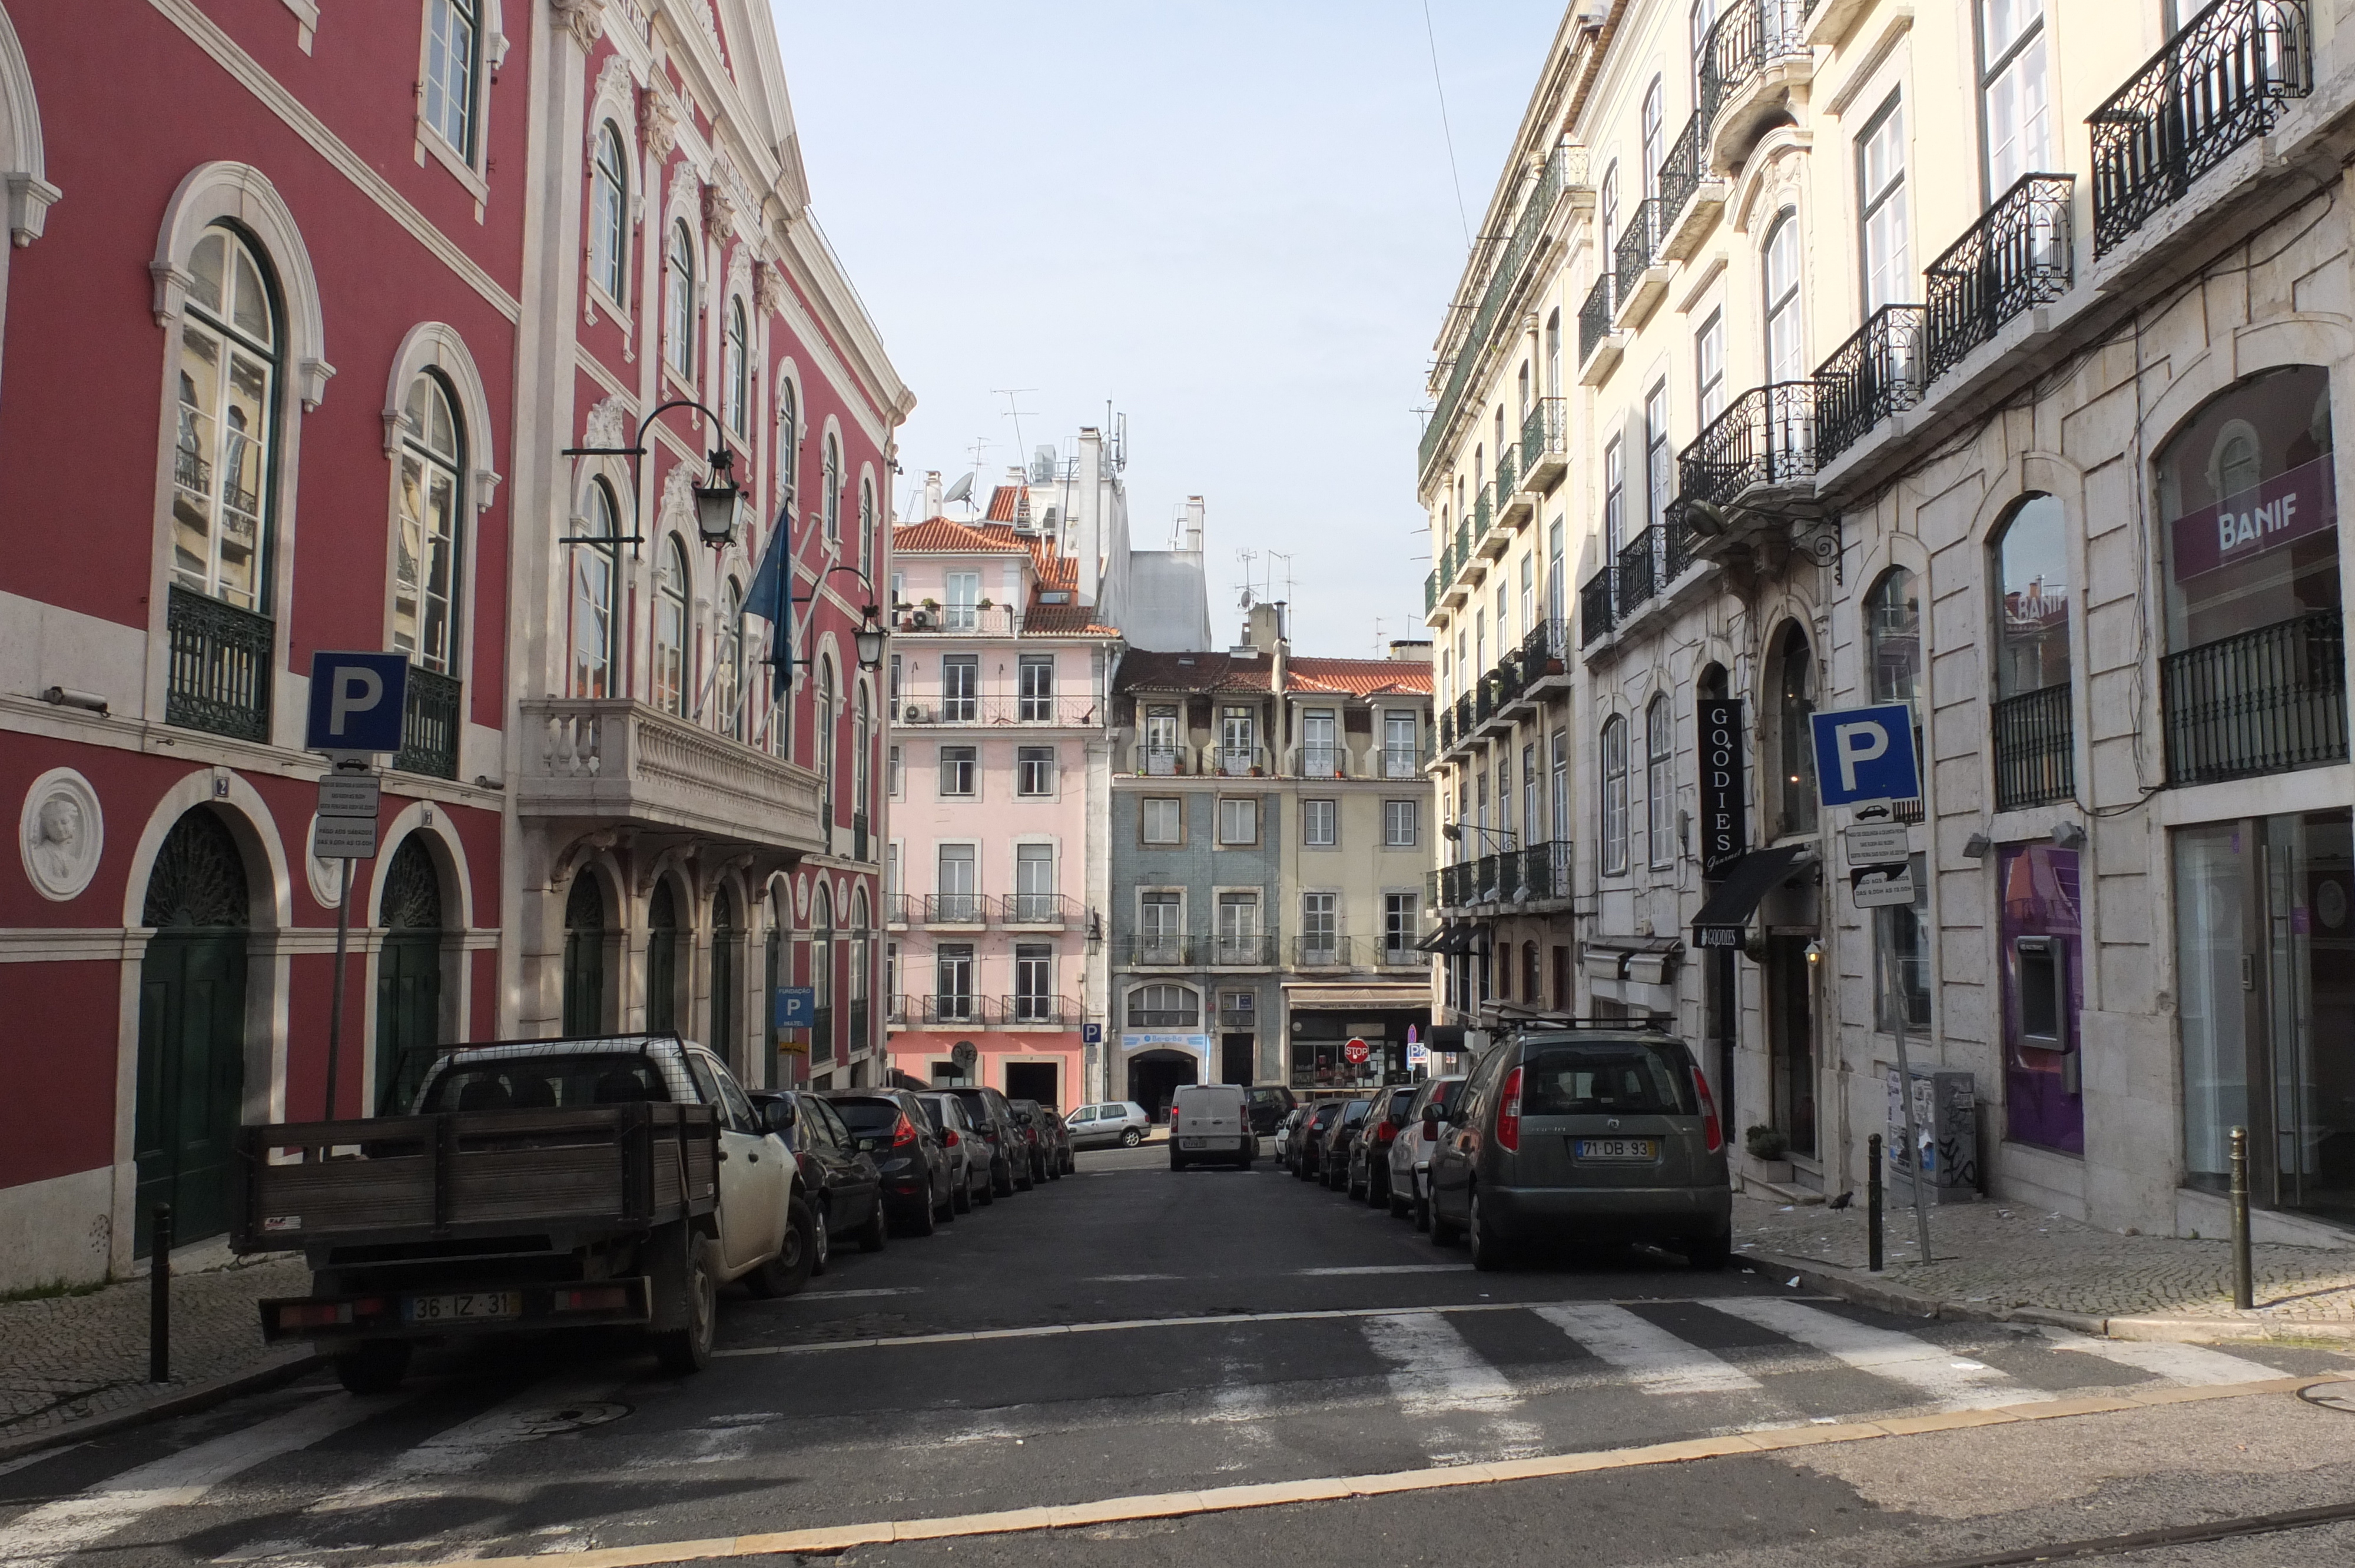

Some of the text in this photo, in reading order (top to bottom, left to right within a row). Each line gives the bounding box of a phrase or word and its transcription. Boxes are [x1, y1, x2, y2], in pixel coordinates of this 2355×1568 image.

[2219, 493, 2296, 551] BANIF
[2018, 596, 2065, 620] BANIF
[330, 666, 383, 735] P
[1835, 720, 1889, 792] P
[1711, 708, 1732, 851] GOODIES
[1707, 848, 1742, 871] Gourmet
[1707, 929, 1736, 948] GOODIES
[787, 999, 801, 1016] P
[1086, 1025, 1097, 1041] P
[1346, 1047, 1368, 1056] STOP
[1411, 1045, 1419, 1057] P
